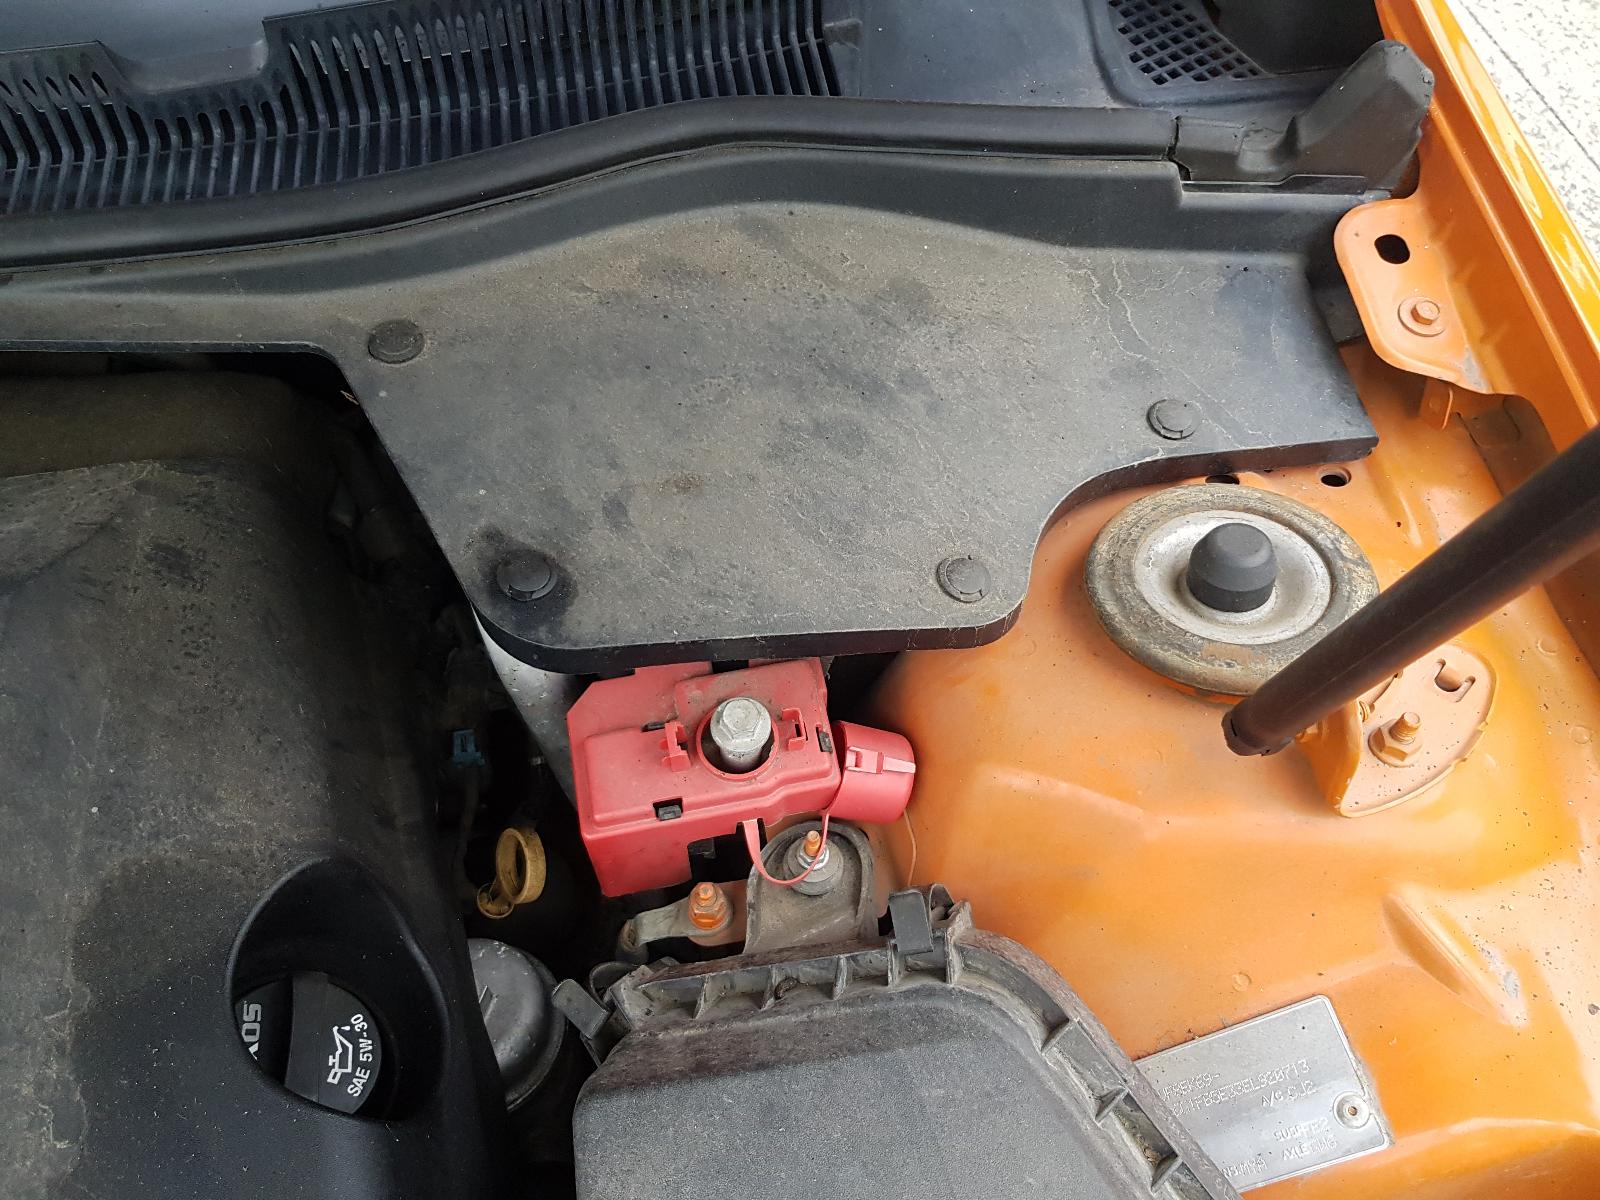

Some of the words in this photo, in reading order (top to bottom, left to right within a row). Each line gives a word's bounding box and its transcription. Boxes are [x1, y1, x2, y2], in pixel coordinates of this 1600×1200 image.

[350, 1014, 373, 1062] 5W-30
[347, 1067, 371, 1096] SAE
[1261, 1090, 1284, 1107] A/C
[1282, 1143, 1309, 1160] AXLE
